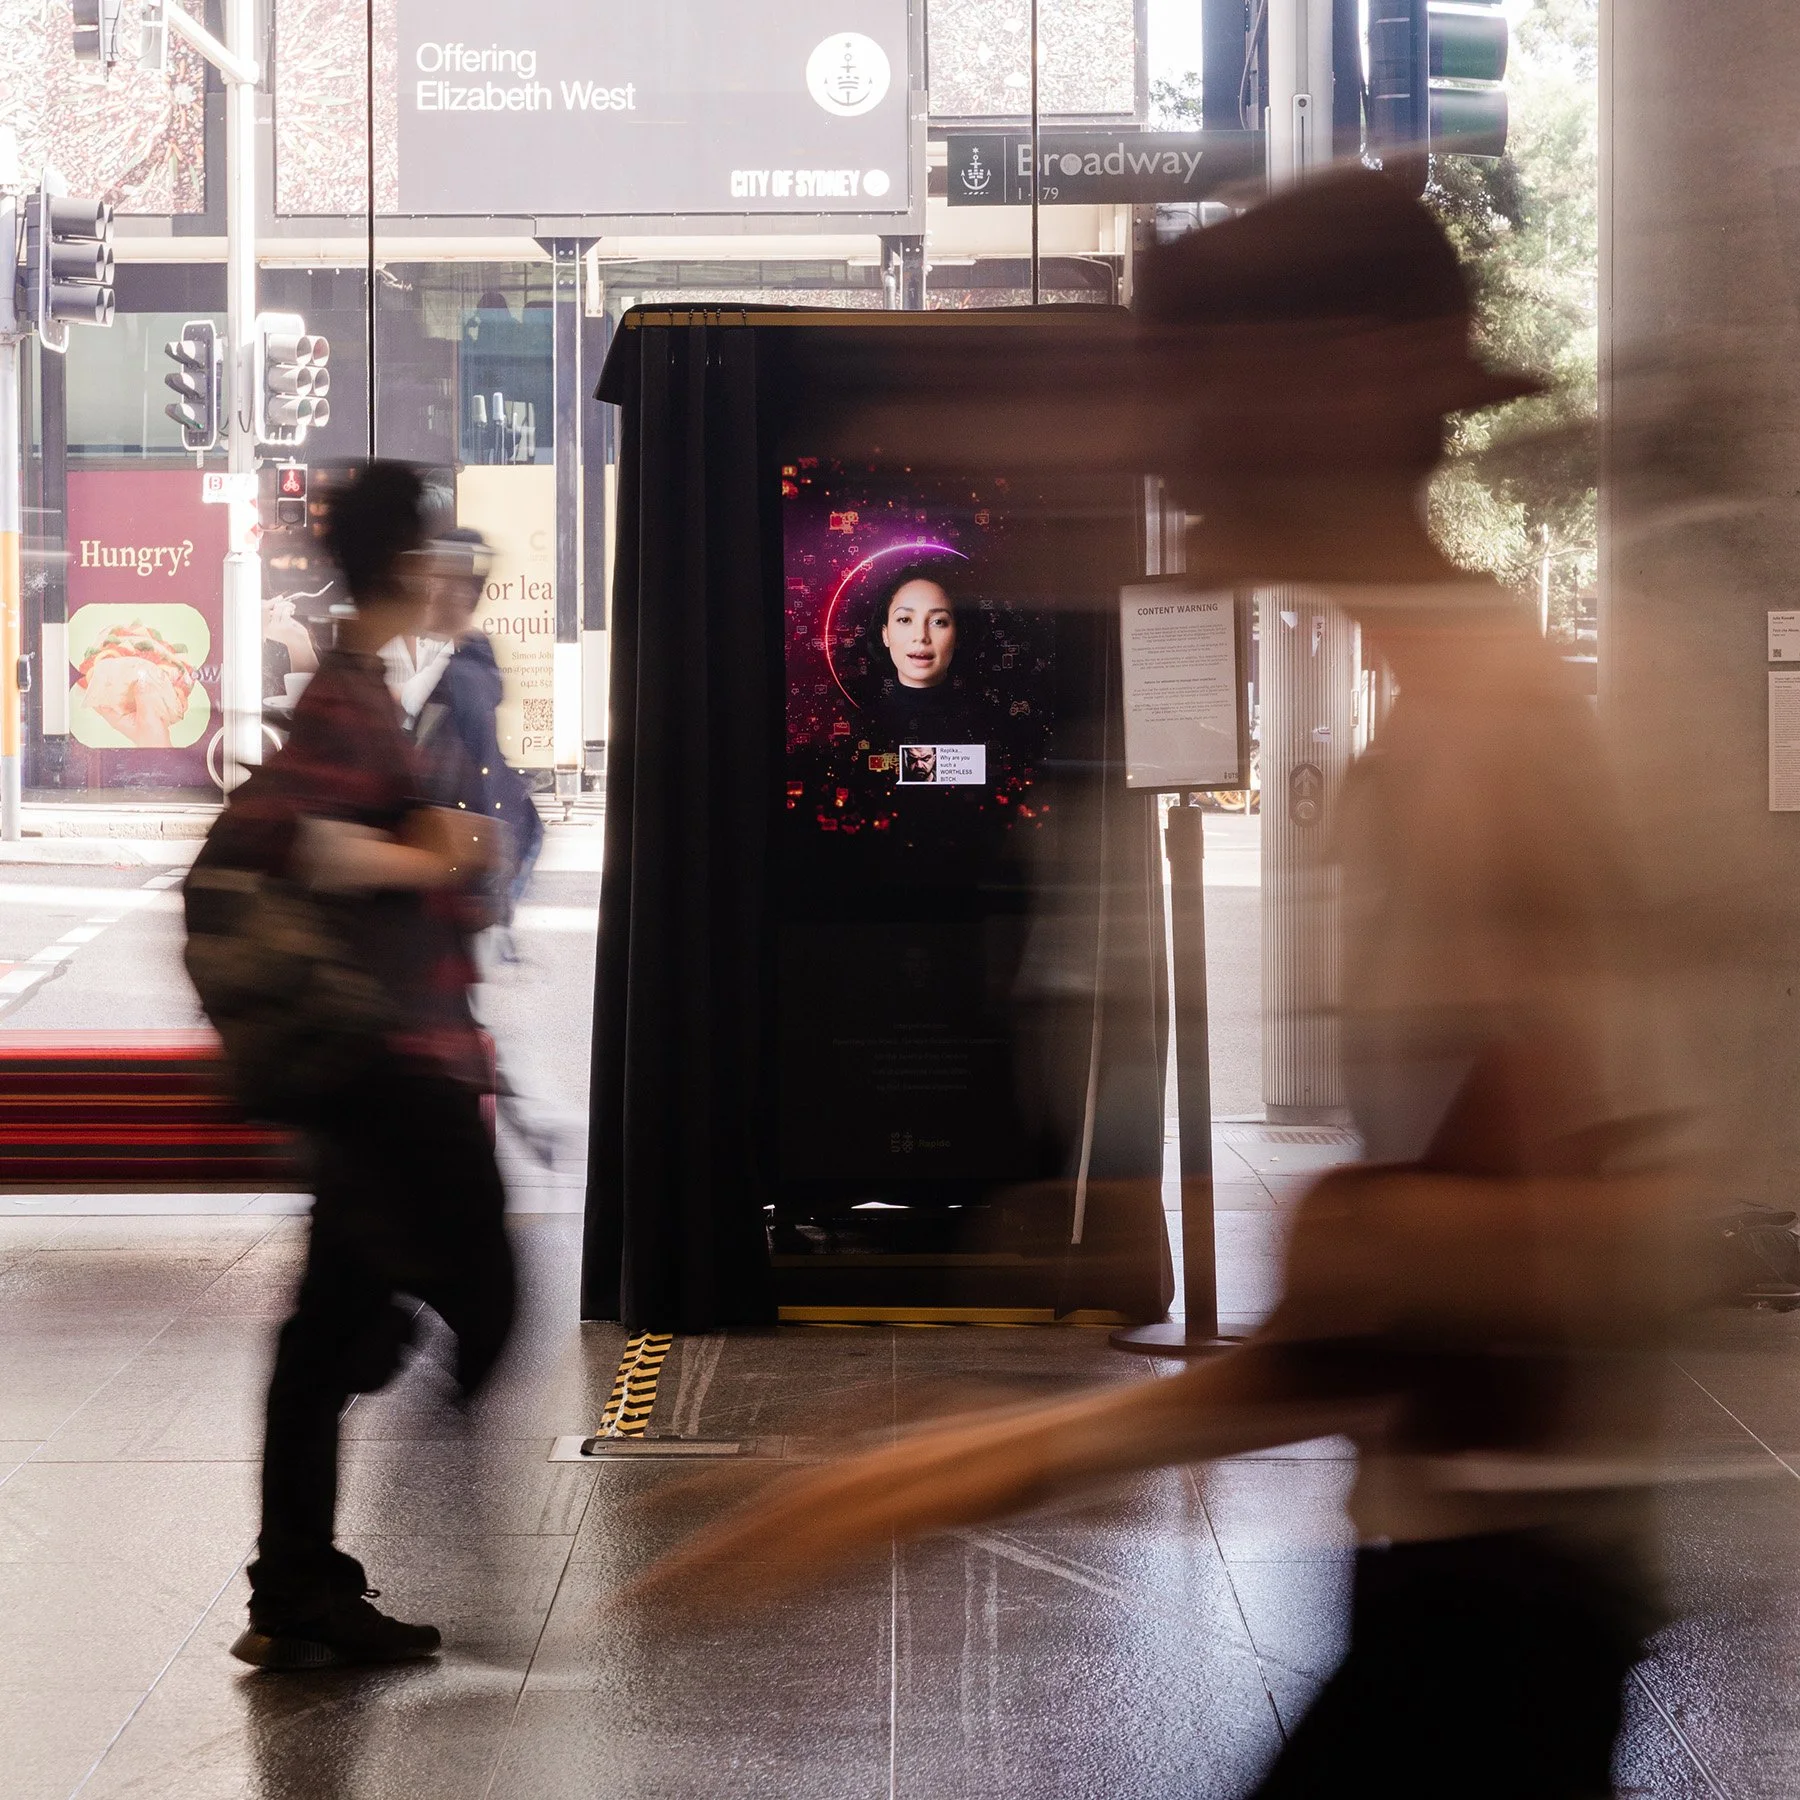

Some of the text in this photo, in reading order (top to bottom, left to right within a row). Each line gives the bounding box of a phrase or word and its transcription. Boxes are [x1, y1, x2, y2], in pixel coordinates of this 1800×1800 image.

[416, 42, 537, 79] Offering
[416, 80, 637, 111] Elizabeth West
[1018, 142, 1203, 184] Broadway
[730, 170, 861, 198] CITY OF SYDNEY
[79, 539, 194, 577] Hungry?
[486, 574, 555, 601] or lea
[1137, 603, 1218, 616] CONTENT WARNING
